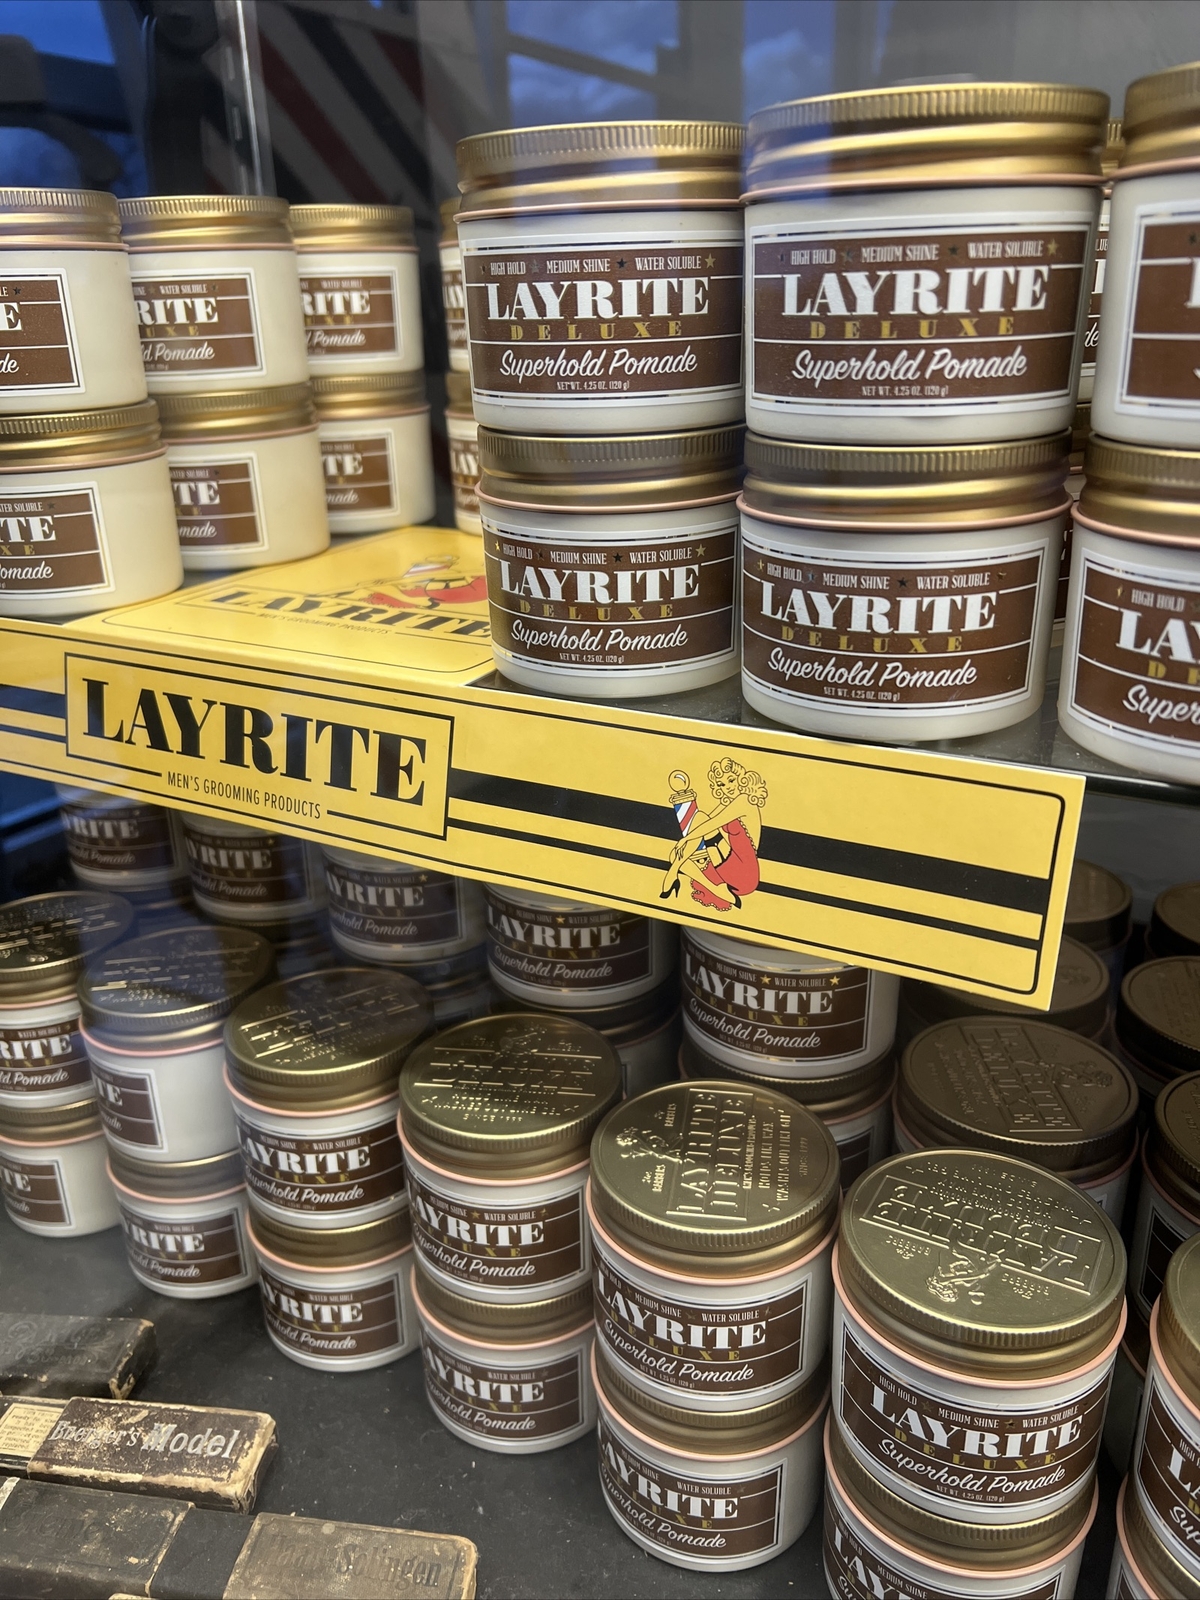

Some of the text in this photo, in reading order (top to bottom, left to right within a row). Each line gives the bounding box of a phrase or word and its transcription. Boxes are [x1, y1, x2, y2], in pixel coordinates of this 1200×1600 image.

[490, 255, 702, 275] HIGH HOLD MEDIUM SHINE WATER SOLUBLE
[791, 240, 1044, 265] HIGH HOLD MEDIUM SHINE WATER SOLUBLE
[299, 290, 371, 316] RITE
[485, 276, 709, 320] LAYRITE
[781, 265, 1049, 316] LAYRITE
[135, 297, 218, 326] RITE
[313, 330, 366, 347] Pomade
[510, 320, 682, 341] DELUXE
[809, 316, 1014, 339] DELUXE
[155, 341, 215, 362] Pomade
[500, 345, 698, 384] Superhold Pomade
[791, 345, 1027, 389] Superhold Pomade
[14, 501, 43, 513] SOLUBLE
[503, 543, 693, 565] HIGH HOLD MEDIUM SHINE WATER SOLUBLE
[0, 561, 54, 580] omade
[499, 559, 699, 604] LAYRITE
[767, 562, 990, 590] HIGH HOLD MEDIUM SHINE WATER SOLUBLE
[210, 590, 491, 639] LAYRITE
[519, 600, 673, 621] DELUXE
[760, 580, 997, 634] LAYRITE
[1131, 589, 1186, 612] HIGH HOLD
[511, 619, 688, 652] Superhold Pomade
[781, 625, 963, 654] DELUXE
[768, 647, 978, 688] Superhold Pomade
[1123, 684, 1200, 724] Super
[82, 678, 427, 807] LAYRITE
[167, 770, 321, 820] MEN'S GROOMING PRODUCTS
[364, 918, 419, 936] Pomade
[487, 904, 621, 949] LAYRITE
[568, 916, 588, 925] WATER
[553, 962, 613, 979] Pomade
[685, 954, 833, 1015] LAYRITE
[738, 968, 757, 983] SHINE
[774, 976, 797, 987] WATER
[798, 977, 827, 988] SOLUBLE
[0, 1033, 73, 1061] RITE
[753, 1027, 821, 1048] Pomade
[13, 1067, 70, 1086] Pomade
[312, 1142, 334, 1151] WATER
[301, 1184, 364, 1204] Pomade
[484, 1213, 506, 1222] WATER
[508, 1211, 536, 1222] SOLUBLE
[150, 1259, 201, 1277] Pomade
[469, 1260, 536, 1278] Pomade
[598, 1268, 766, 1350] LAYRITE
[635, 1292, 760, 1323] MEDIUM SHINE WATER SOLUBLE
[300, 1332, 357, 1349] Pomade
[611, 1310, 740, 1361] DELUXE
[603, 1318, 675, 1375] Superhold
[678, 1363, 754, 1383] Pomade
[424, 1347, 544, 1403] AYRITE
[879, 1374, 1079, 1429] HIGH HOLD MEDIUM SHINE WATER SOLUBLE
[473, 1412, 537, 1430] Pomade
[870, 1384, 1083, 1460] LAYRITE
[141, 1422, 240, 1459] Model
[894, 1428, 1057, 1470] DELUXE
[602, 1441, 738, 1519] AYRITE
[878, 1438, 1066, 1494] Superhold Pomade
[677, 1481, 699, 1494] WATER
[701, 1484, 731, 1495] SOLUBLE
[657, 1520, 727, 1548] Pomade
[877, 1564, 904, 1588] MEDIUM
